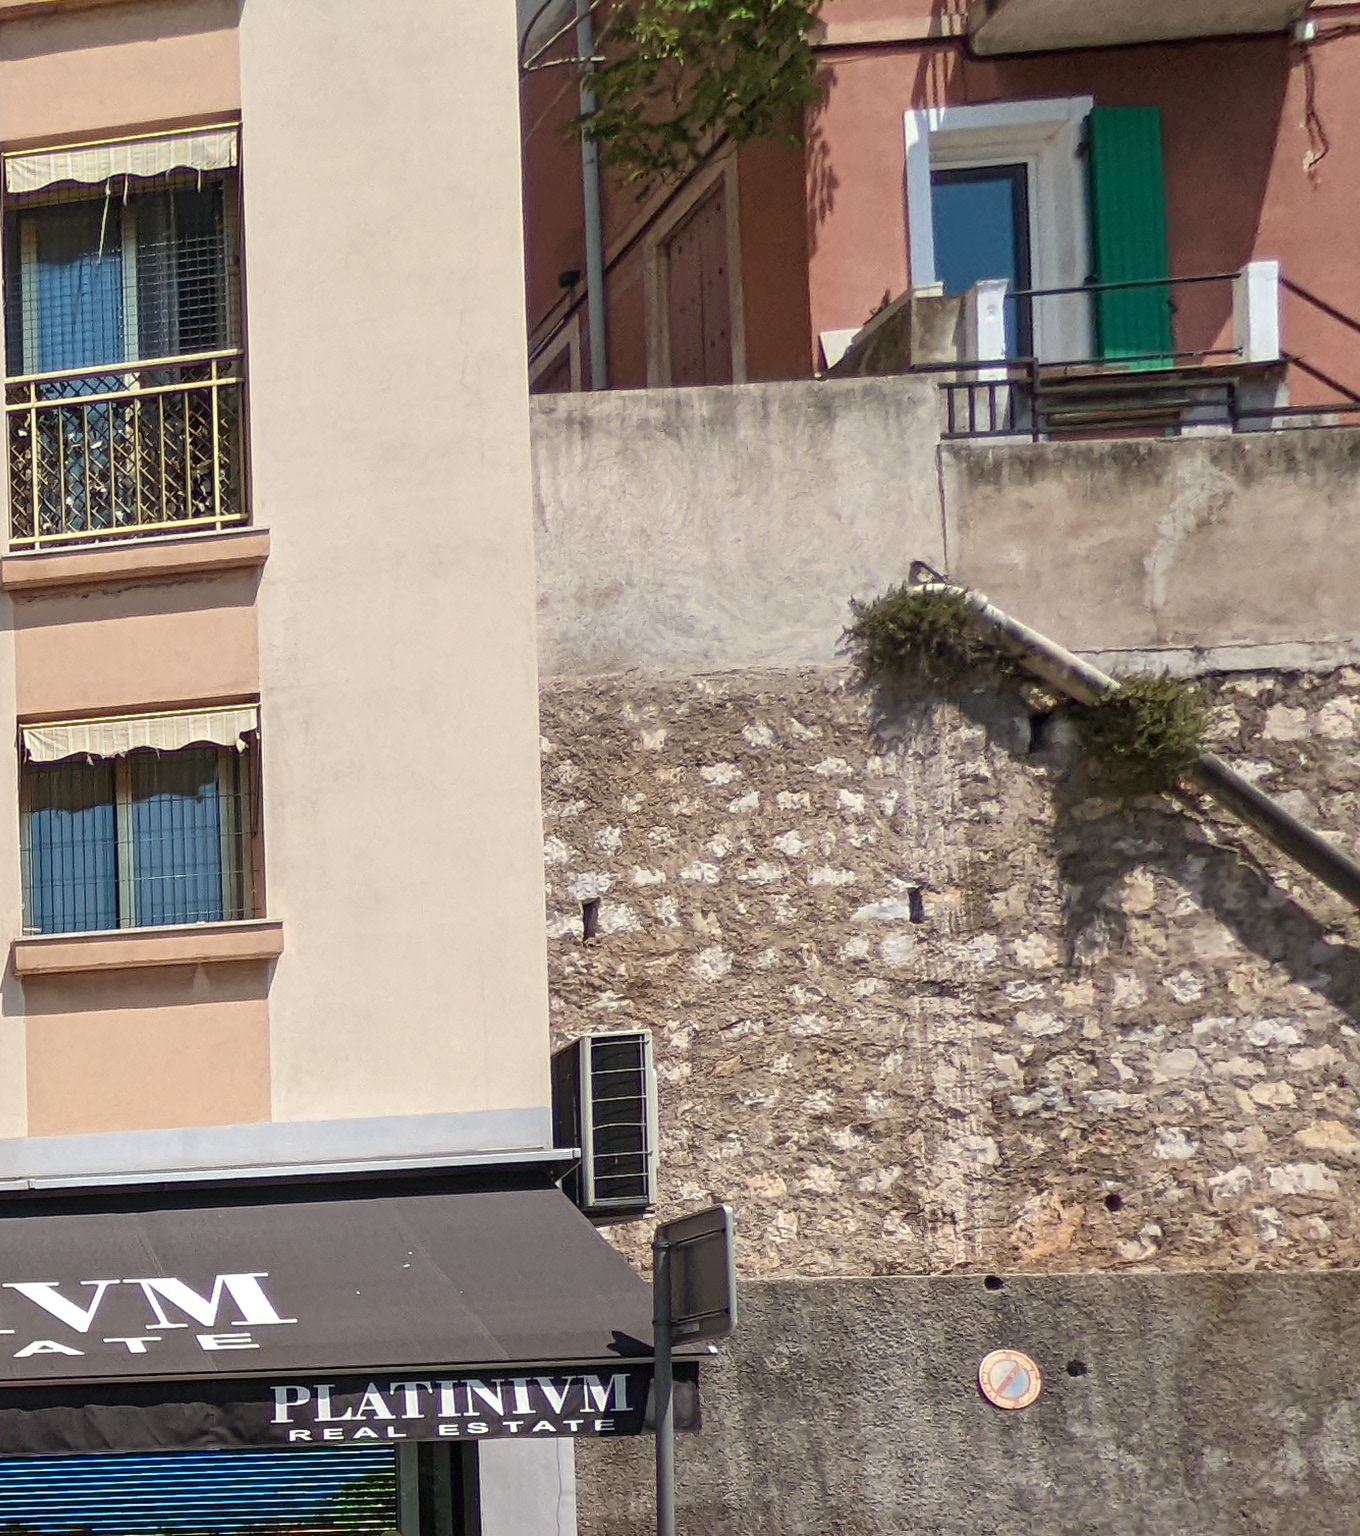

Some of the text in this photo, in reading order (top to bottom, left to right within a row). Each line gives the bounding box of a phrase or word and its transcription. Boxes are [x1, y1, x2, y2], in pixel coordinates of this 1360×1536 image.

[270, 1373, 633, 1423] PLATINIVM
[289, 1419, 616, 1442] REAL ESTATE
